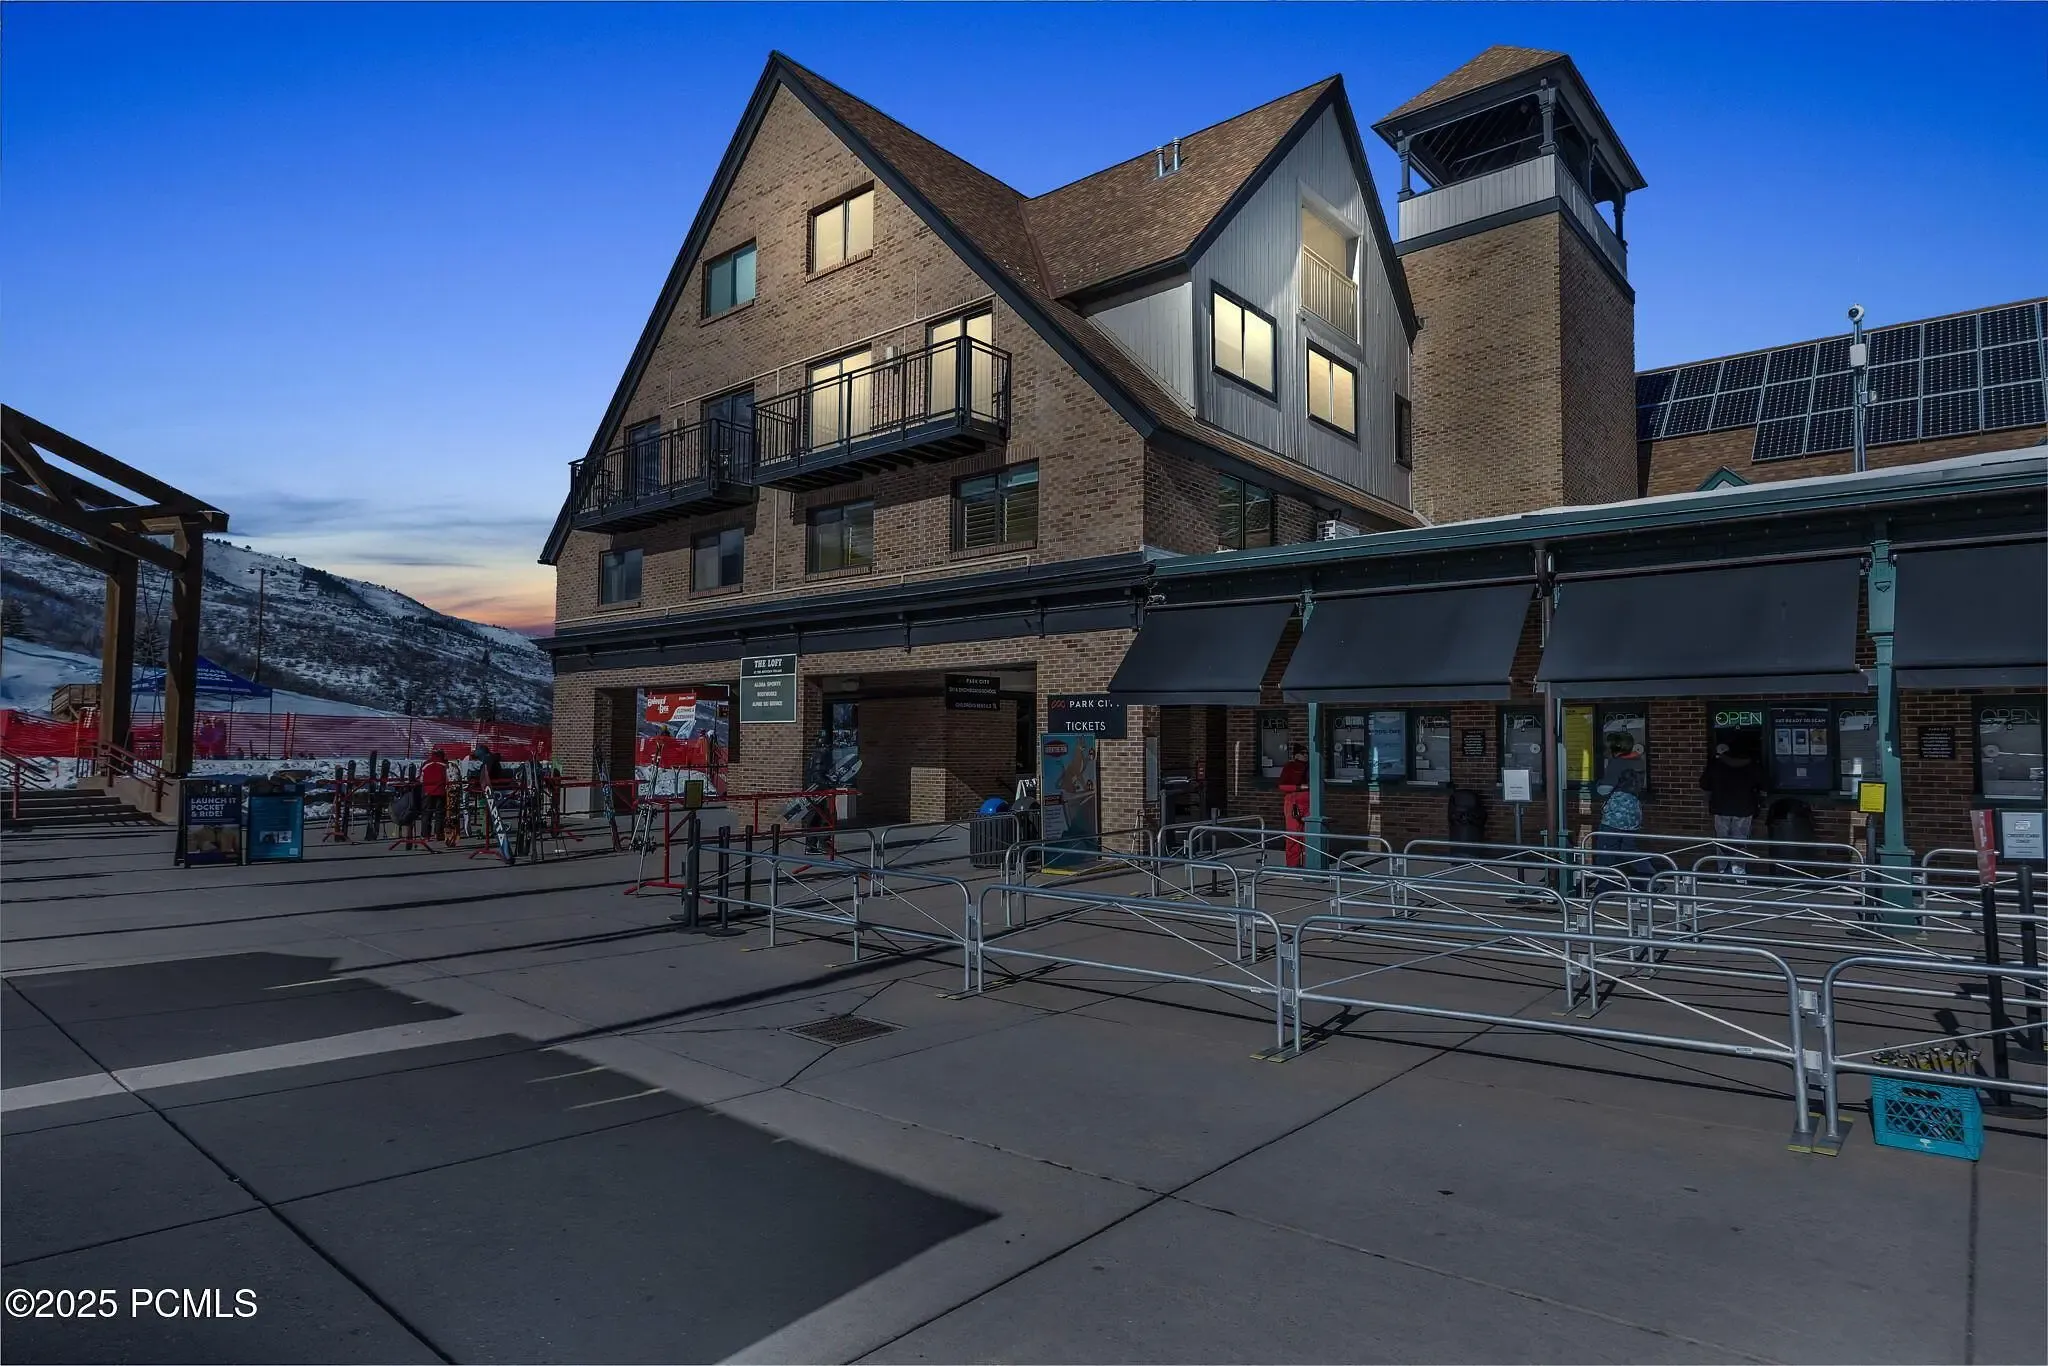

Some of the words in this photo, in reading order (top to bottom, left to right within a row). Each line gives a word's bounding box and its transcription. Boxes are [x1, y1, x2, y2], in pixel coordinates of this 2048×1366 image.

[754, 659, 767, 668] THE
[767, 658, 783, 667] LOFT
[1069, 700, 1094, 709] PARK
[1715, 711, 1762, 726] OPEN
[1980, 708, 2041, 724] OPEN
[1065, 721, 1106, 731] TICKETS
